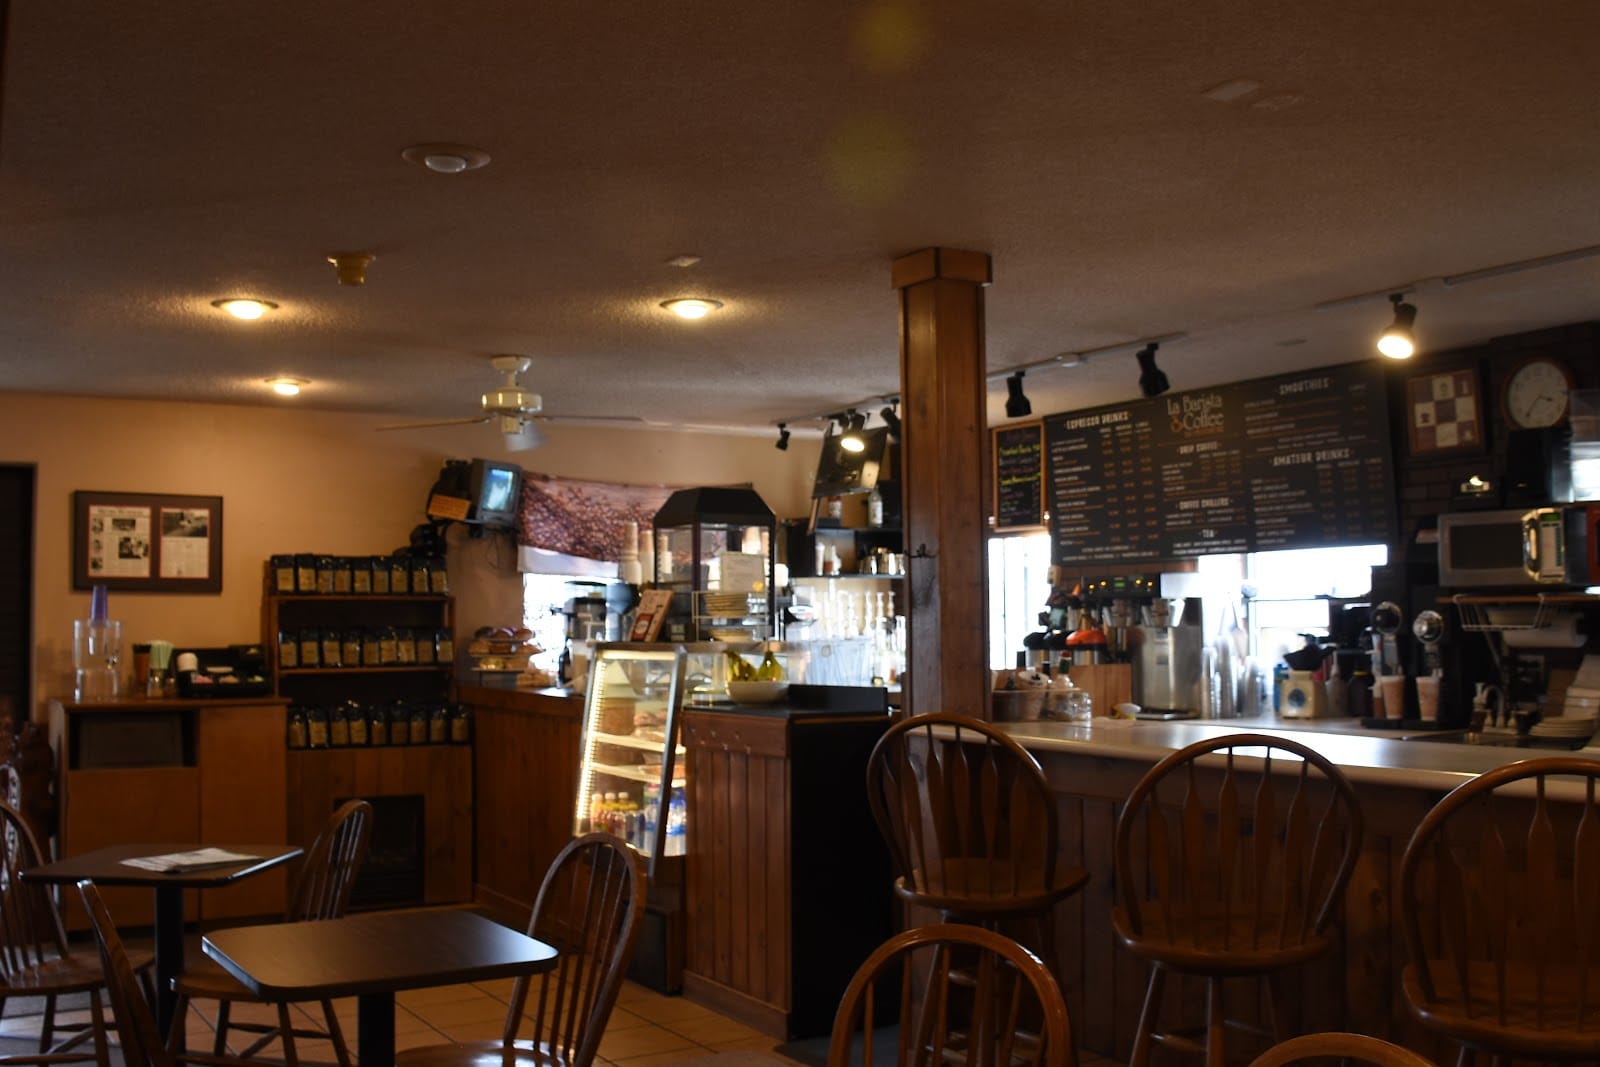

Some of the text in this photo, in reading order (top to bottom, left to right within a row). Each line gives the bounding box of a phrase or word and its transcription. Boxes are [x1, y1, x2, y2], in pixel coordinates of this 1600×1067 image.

[1279, 377, 1330, 395] SMOOTHIES
[1167, 398, 1180, 416] La
[1183, 393, 1223, 412] Barista
[1066, 415, 1100, 430] ESPRESSO
[1101, 410, 1129, 425] DRINKS
[1183, 408, 1224, 430] Coffee
[1272, 452, 1312, 467] AMATEUR
[1315, 448, 1350, 462] DRINKS
